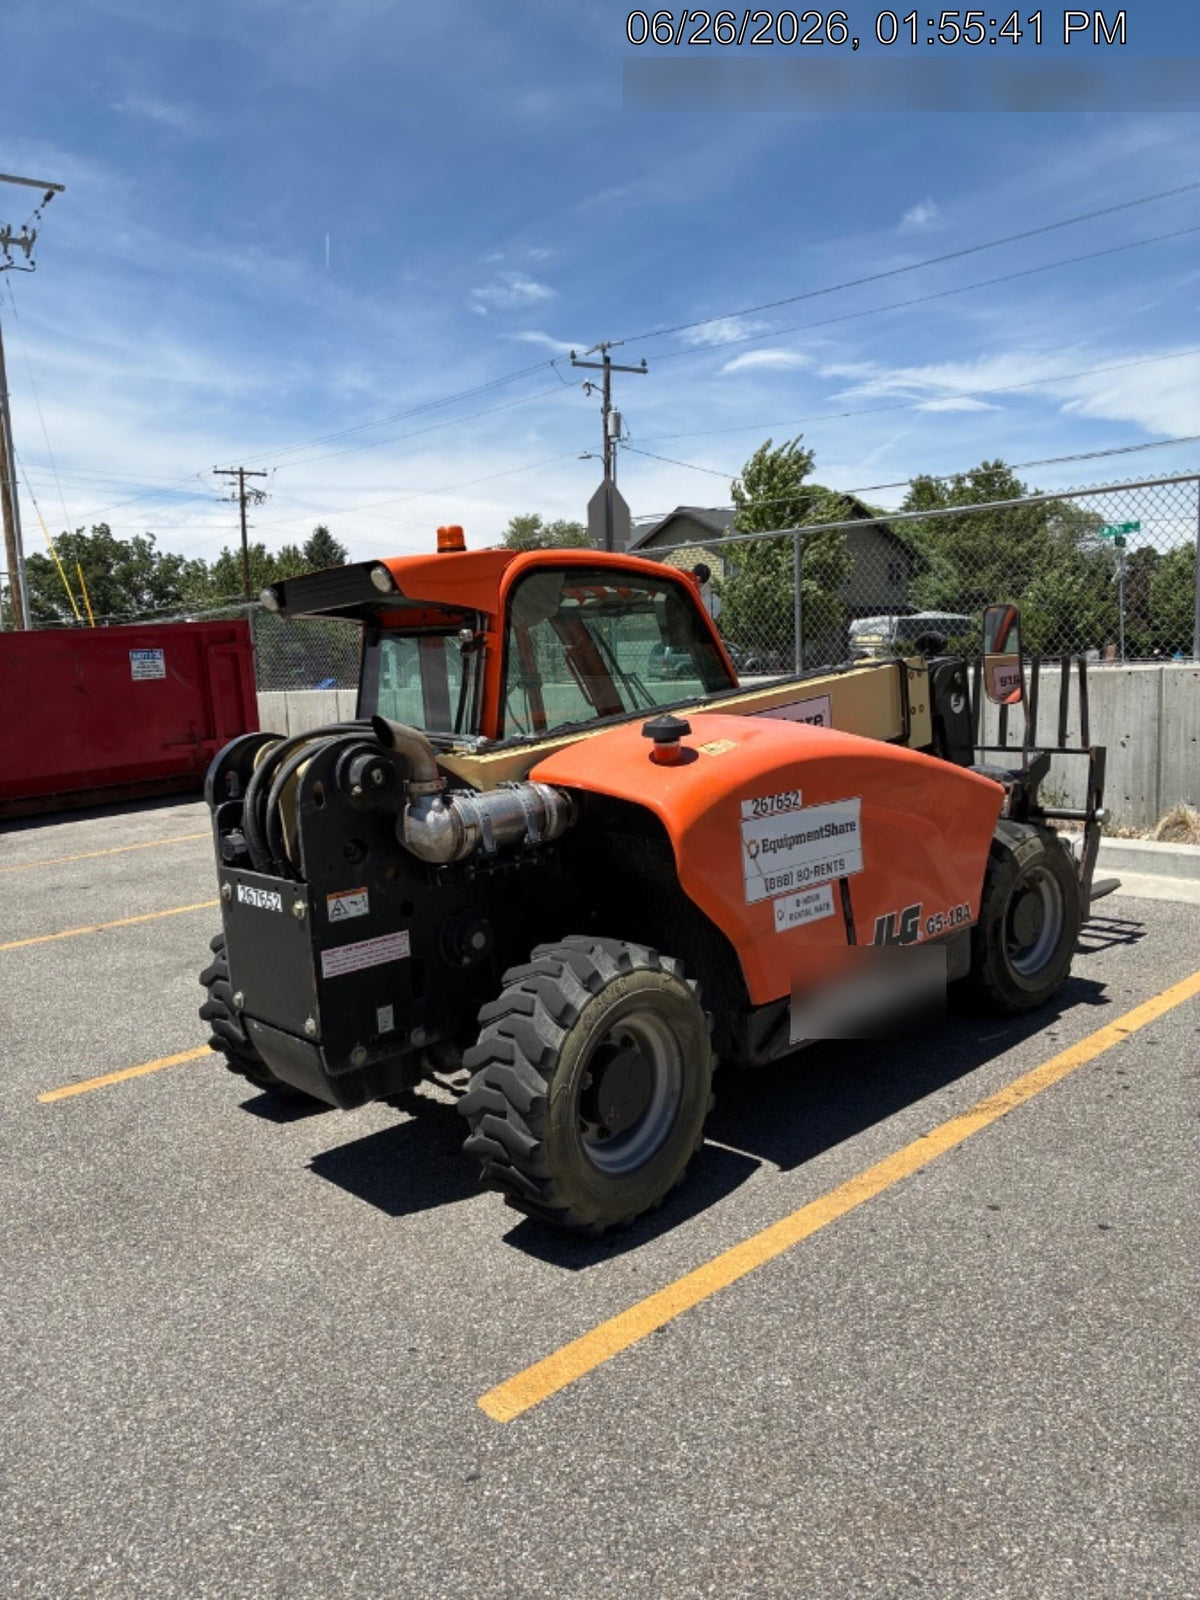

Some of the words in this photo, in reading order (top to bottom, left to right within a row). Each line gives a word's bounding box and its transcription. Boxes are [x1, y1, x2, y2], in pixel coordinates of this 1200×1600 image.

[751, 790, 800, 815] 267652
[761, 820, 857, 854] EquipmentShare
[925, 903, 971, 935] G5-18A
